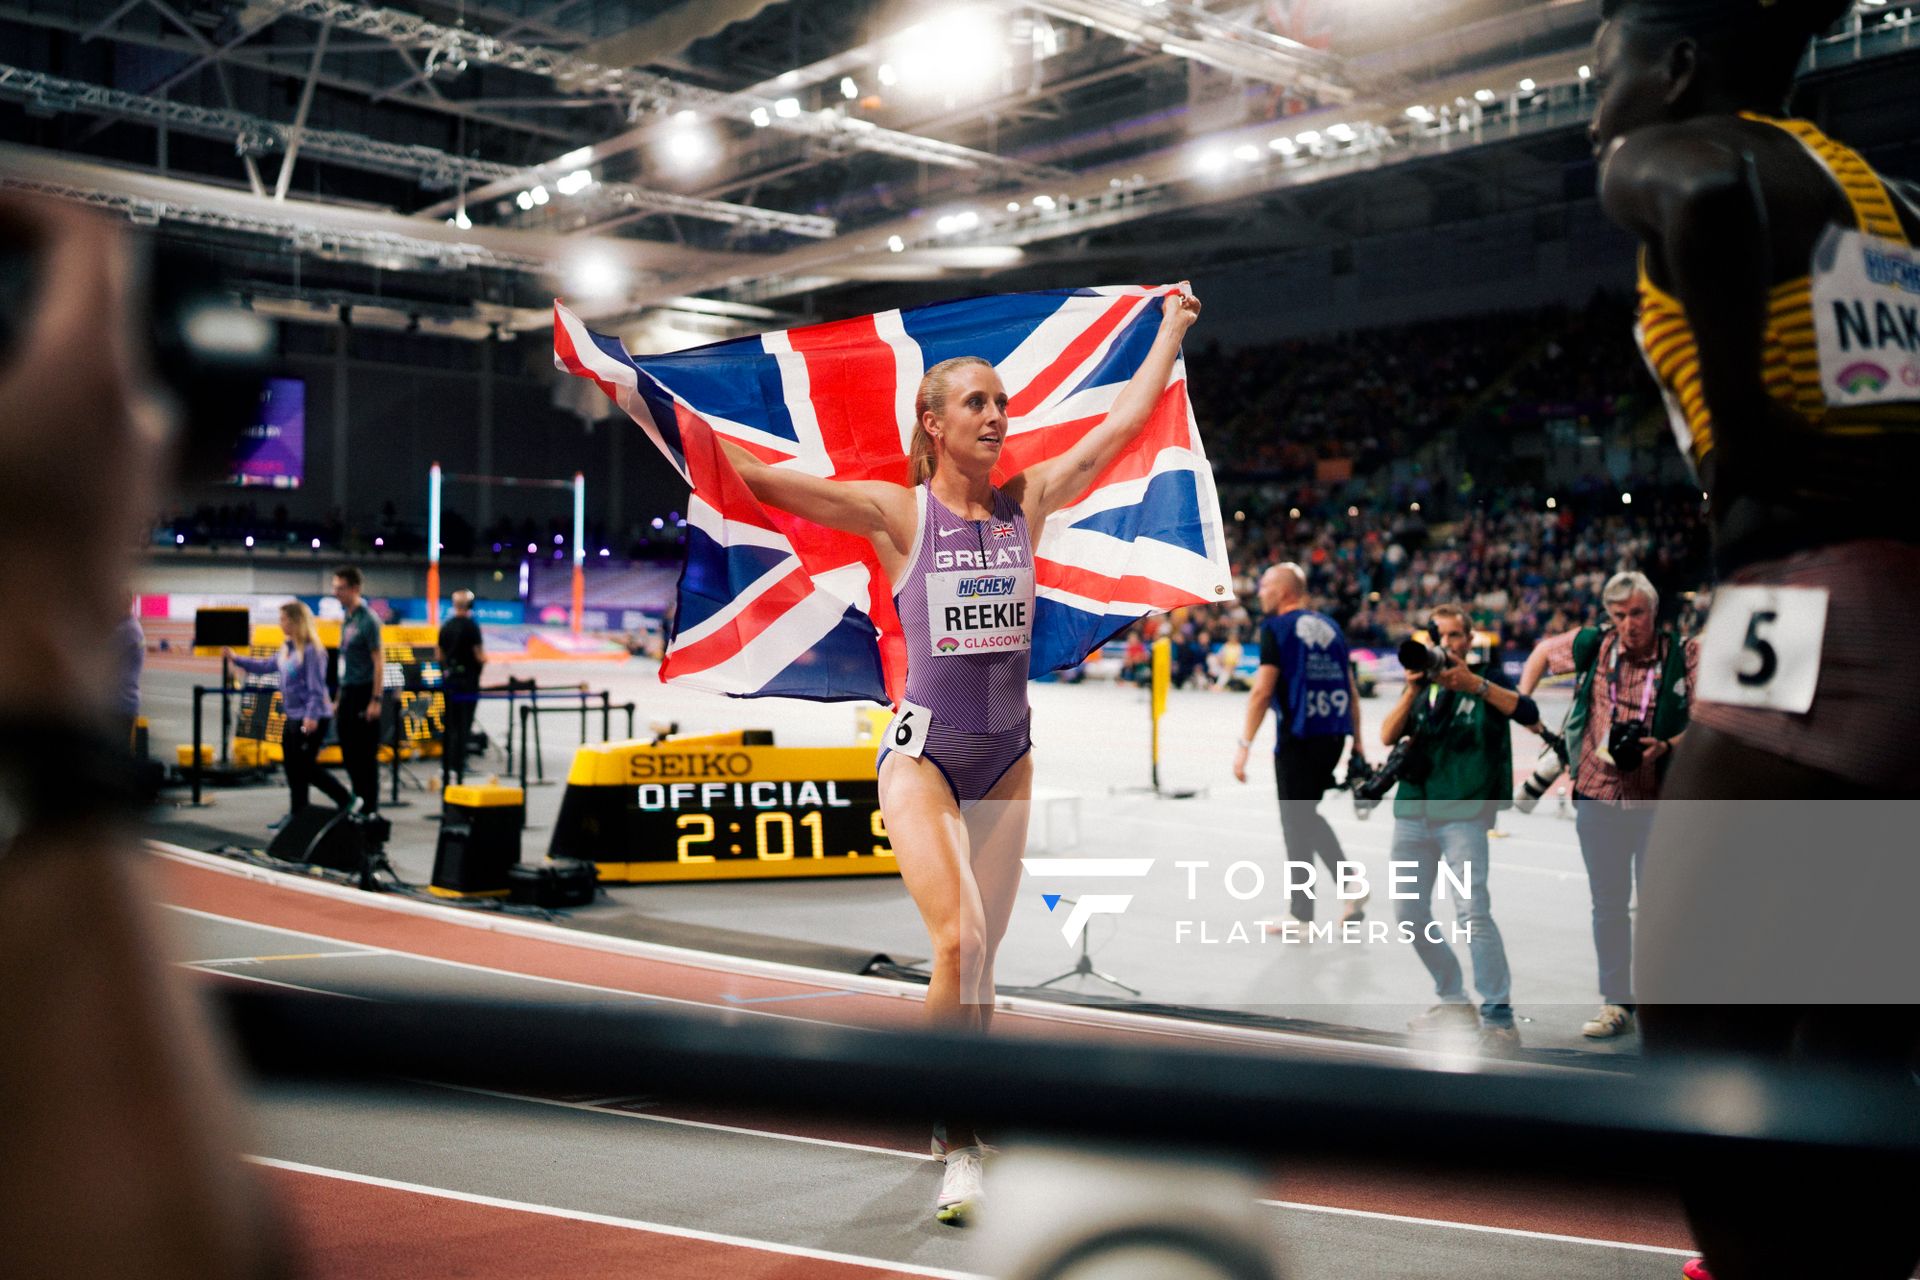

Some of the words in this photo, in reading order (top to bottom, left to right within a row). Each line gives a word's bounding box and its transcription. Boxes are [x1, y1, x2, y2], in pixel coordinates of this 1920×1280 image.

[935, 547, 1022, 568] GREAT
[957, 575, 1016, 597] HI-CHEW
[945, 602, 1026, 631] REEKIE
[964, 635, 1021, 649] GLASGOW
[1737, 610, 1778, 688] 5
[895, 710, 914, 746] 6
[630, 752, 752, 778] SEIKO
[638, 781, 851, 811] OFFICIAL
